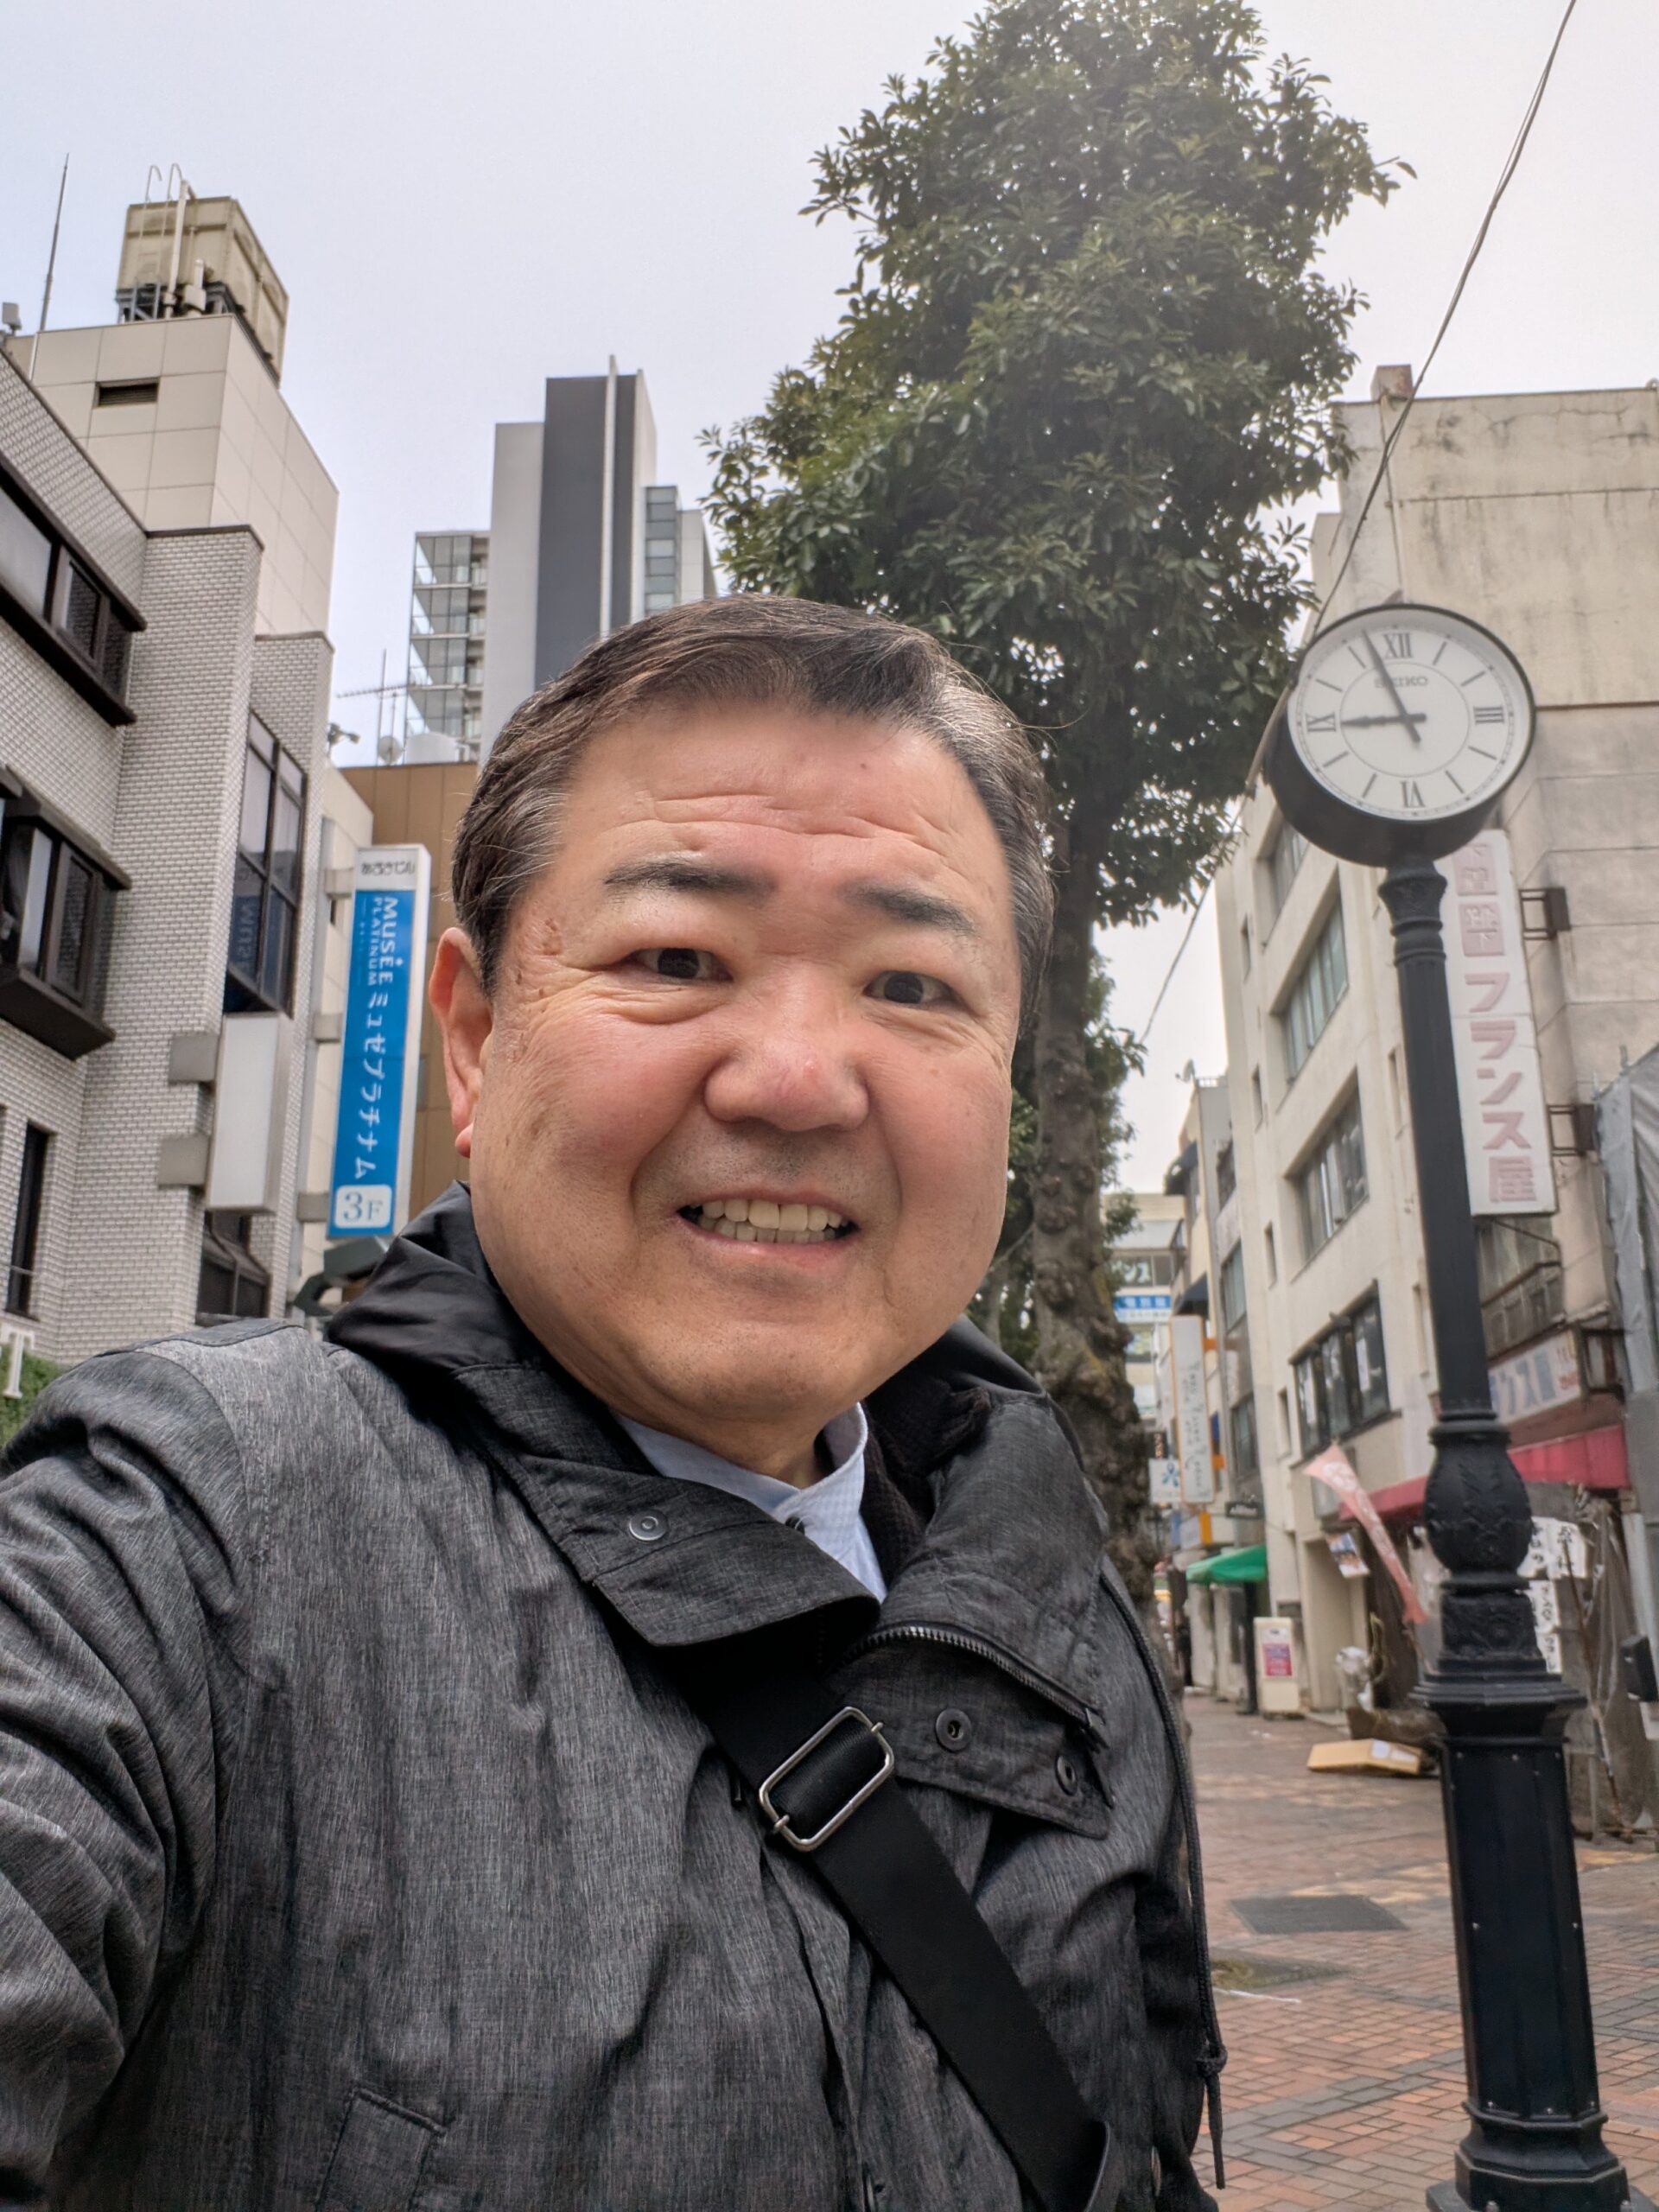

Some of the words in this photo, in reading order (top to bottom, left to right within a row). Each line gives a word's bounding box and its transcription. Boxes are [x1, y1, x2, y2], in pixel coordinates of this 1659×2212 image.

[1383, 632, 1413, 659] XII
[368, 896, 383, 986] PLATINUM
[354, 990, 389, 1180] ミュゼプラチナム
[1464, 972, 1537, 1204] フランス屋
[343, 1192, 384, 1223] 3F
